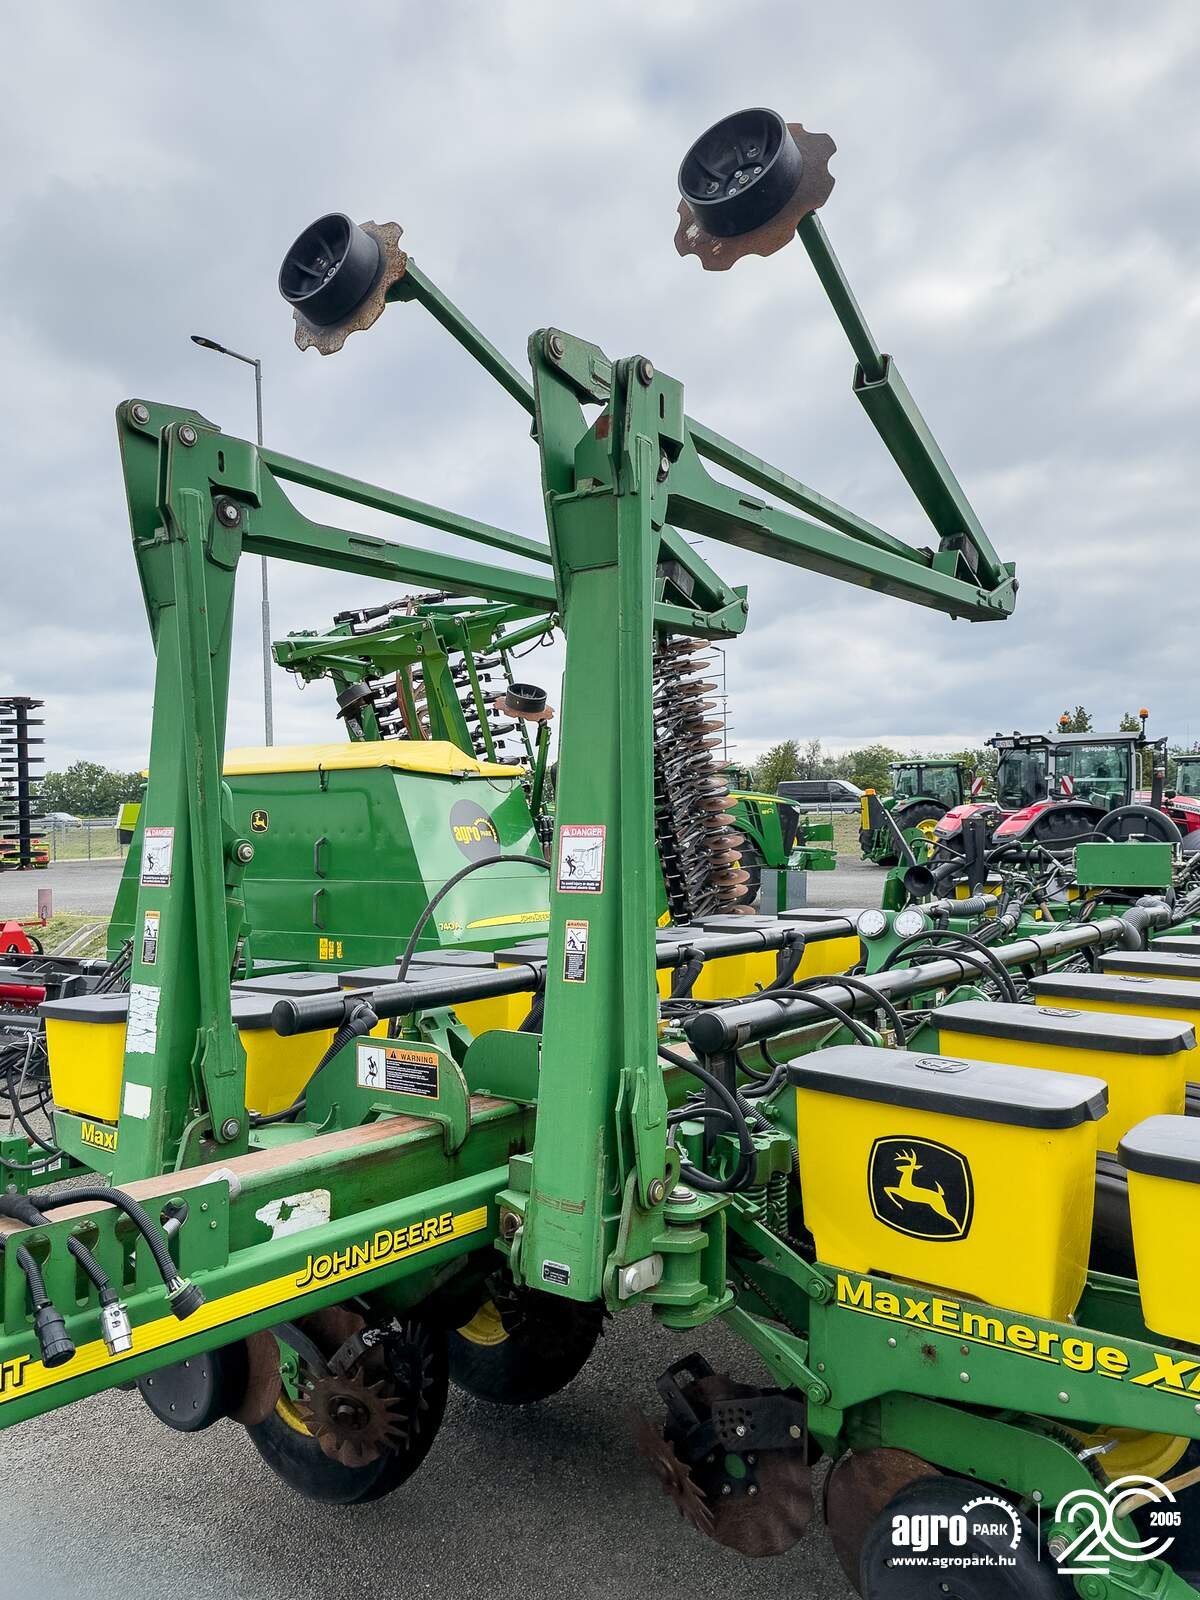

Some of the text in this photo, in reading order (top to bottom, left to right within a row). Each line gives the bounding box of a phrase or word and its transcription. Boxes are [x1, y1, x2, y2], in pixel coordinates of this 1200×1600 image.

[1176, 803, 1200, 813] ERGUSON
[453, 825, 481, 844] agro
[571, 827, 602, 837] DANGER
[400, 1053, 434, 1065] WARNING
[837, 1273, 1200, 1394] MaxEmerge X
